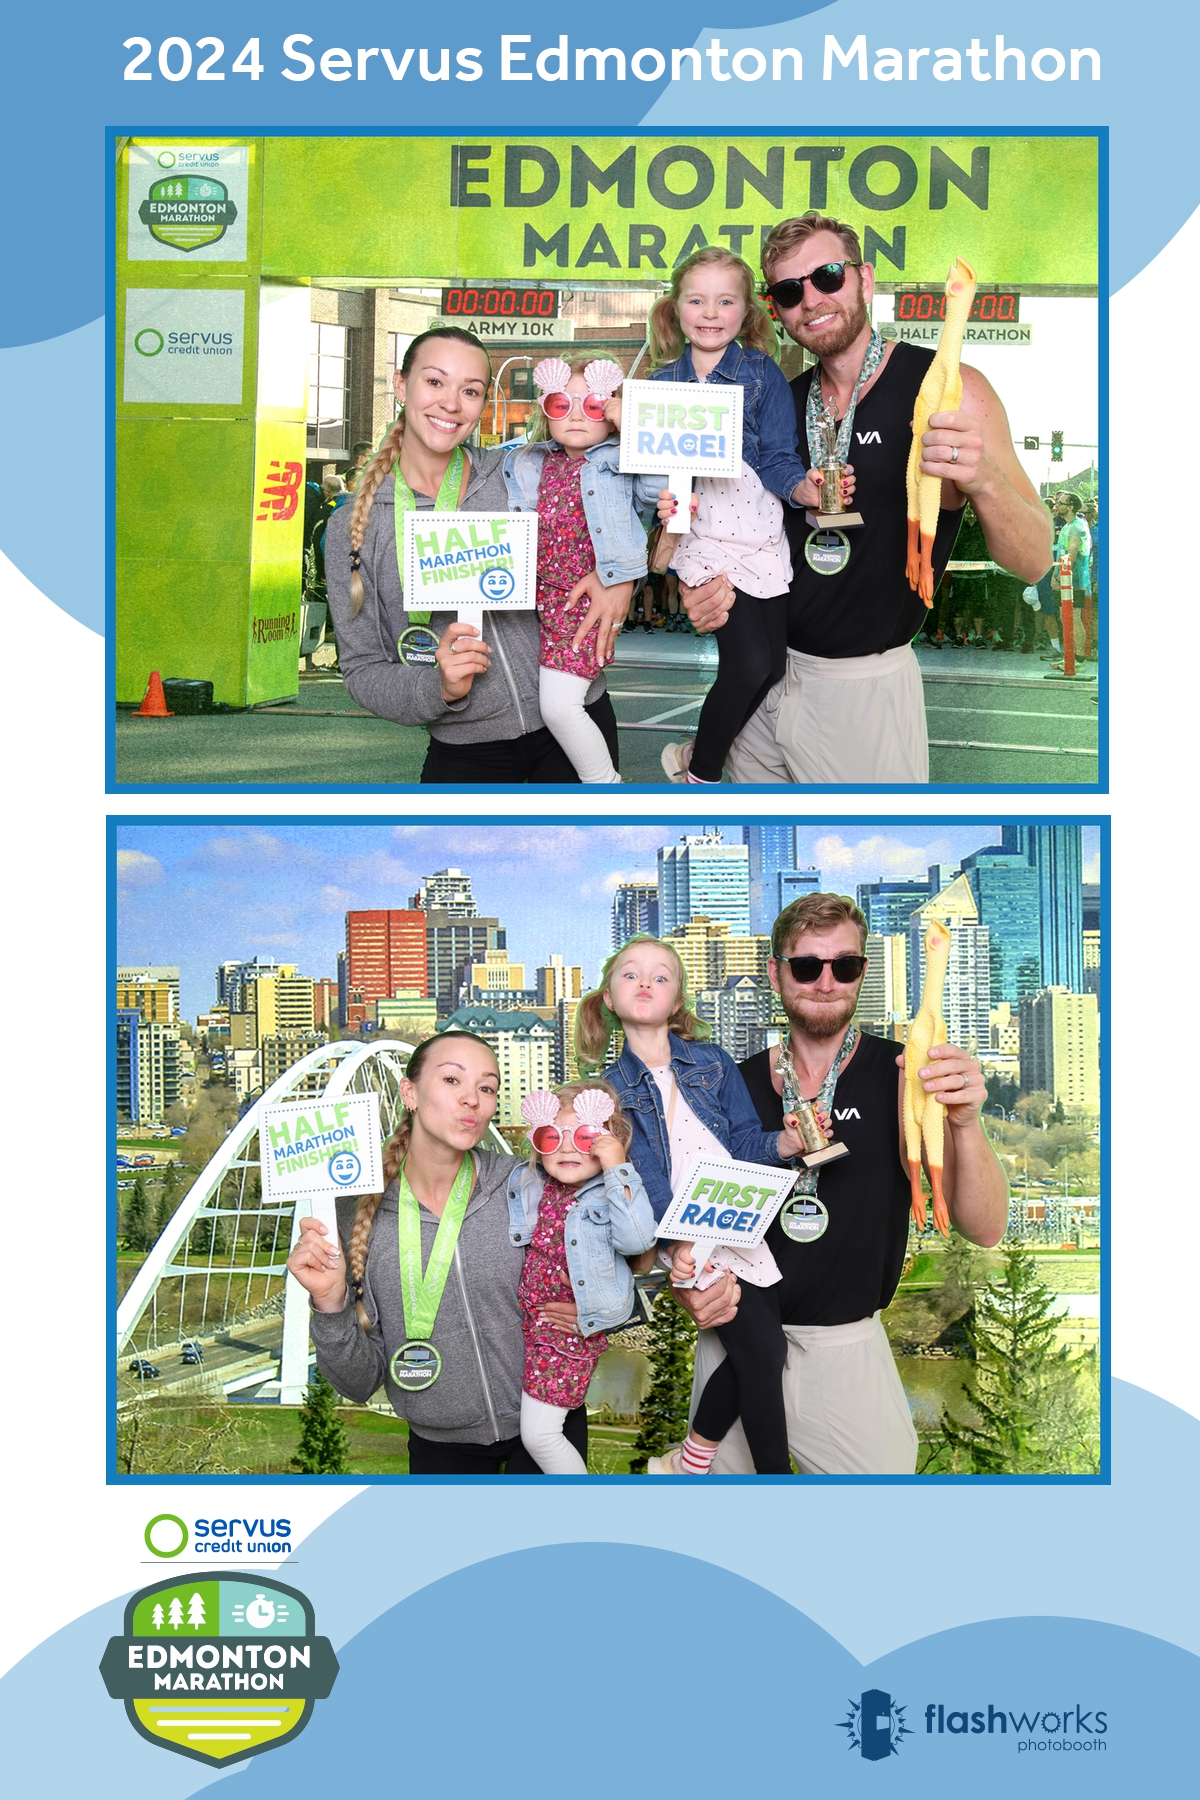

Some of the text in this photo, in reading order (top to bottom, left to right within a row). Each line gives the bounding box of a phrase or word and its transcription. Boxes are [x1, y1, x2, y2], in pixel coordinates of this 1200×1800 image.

[178, 152, 220, 161] servus
[450, 144, 990, 211] EDMONTON
[149, 203, 227, 214] EDMONTON
[160, 214, 216, 222] MARATHON
[168, 332, 233, 345] servus
[467, 321, 555, 336] ARMY 10K
[900, 328, 1031, 341] HALF RATHON
[168, 345, 233, 355] credit union
[637, 402, 730, 431] FIRST
[637, 431, 726, 458] RACE!
[856, 431, 882, 445] VA
[414, 518, 508, 558] HALF
[419, 542, 512, 570] MARATHON
[421, 555, 515, 586] FINISHER!
[268, 1101, 350, 1149] HALF
[834, 1108, 861, 1121] VA
[273, 1125, 355, 1161] MARATHON
[276, 1138, 360, 1177] FINISHER!
[691, 1177, 778, 1210] FIRST
[679, 1203, 761, 1233] RACE!
